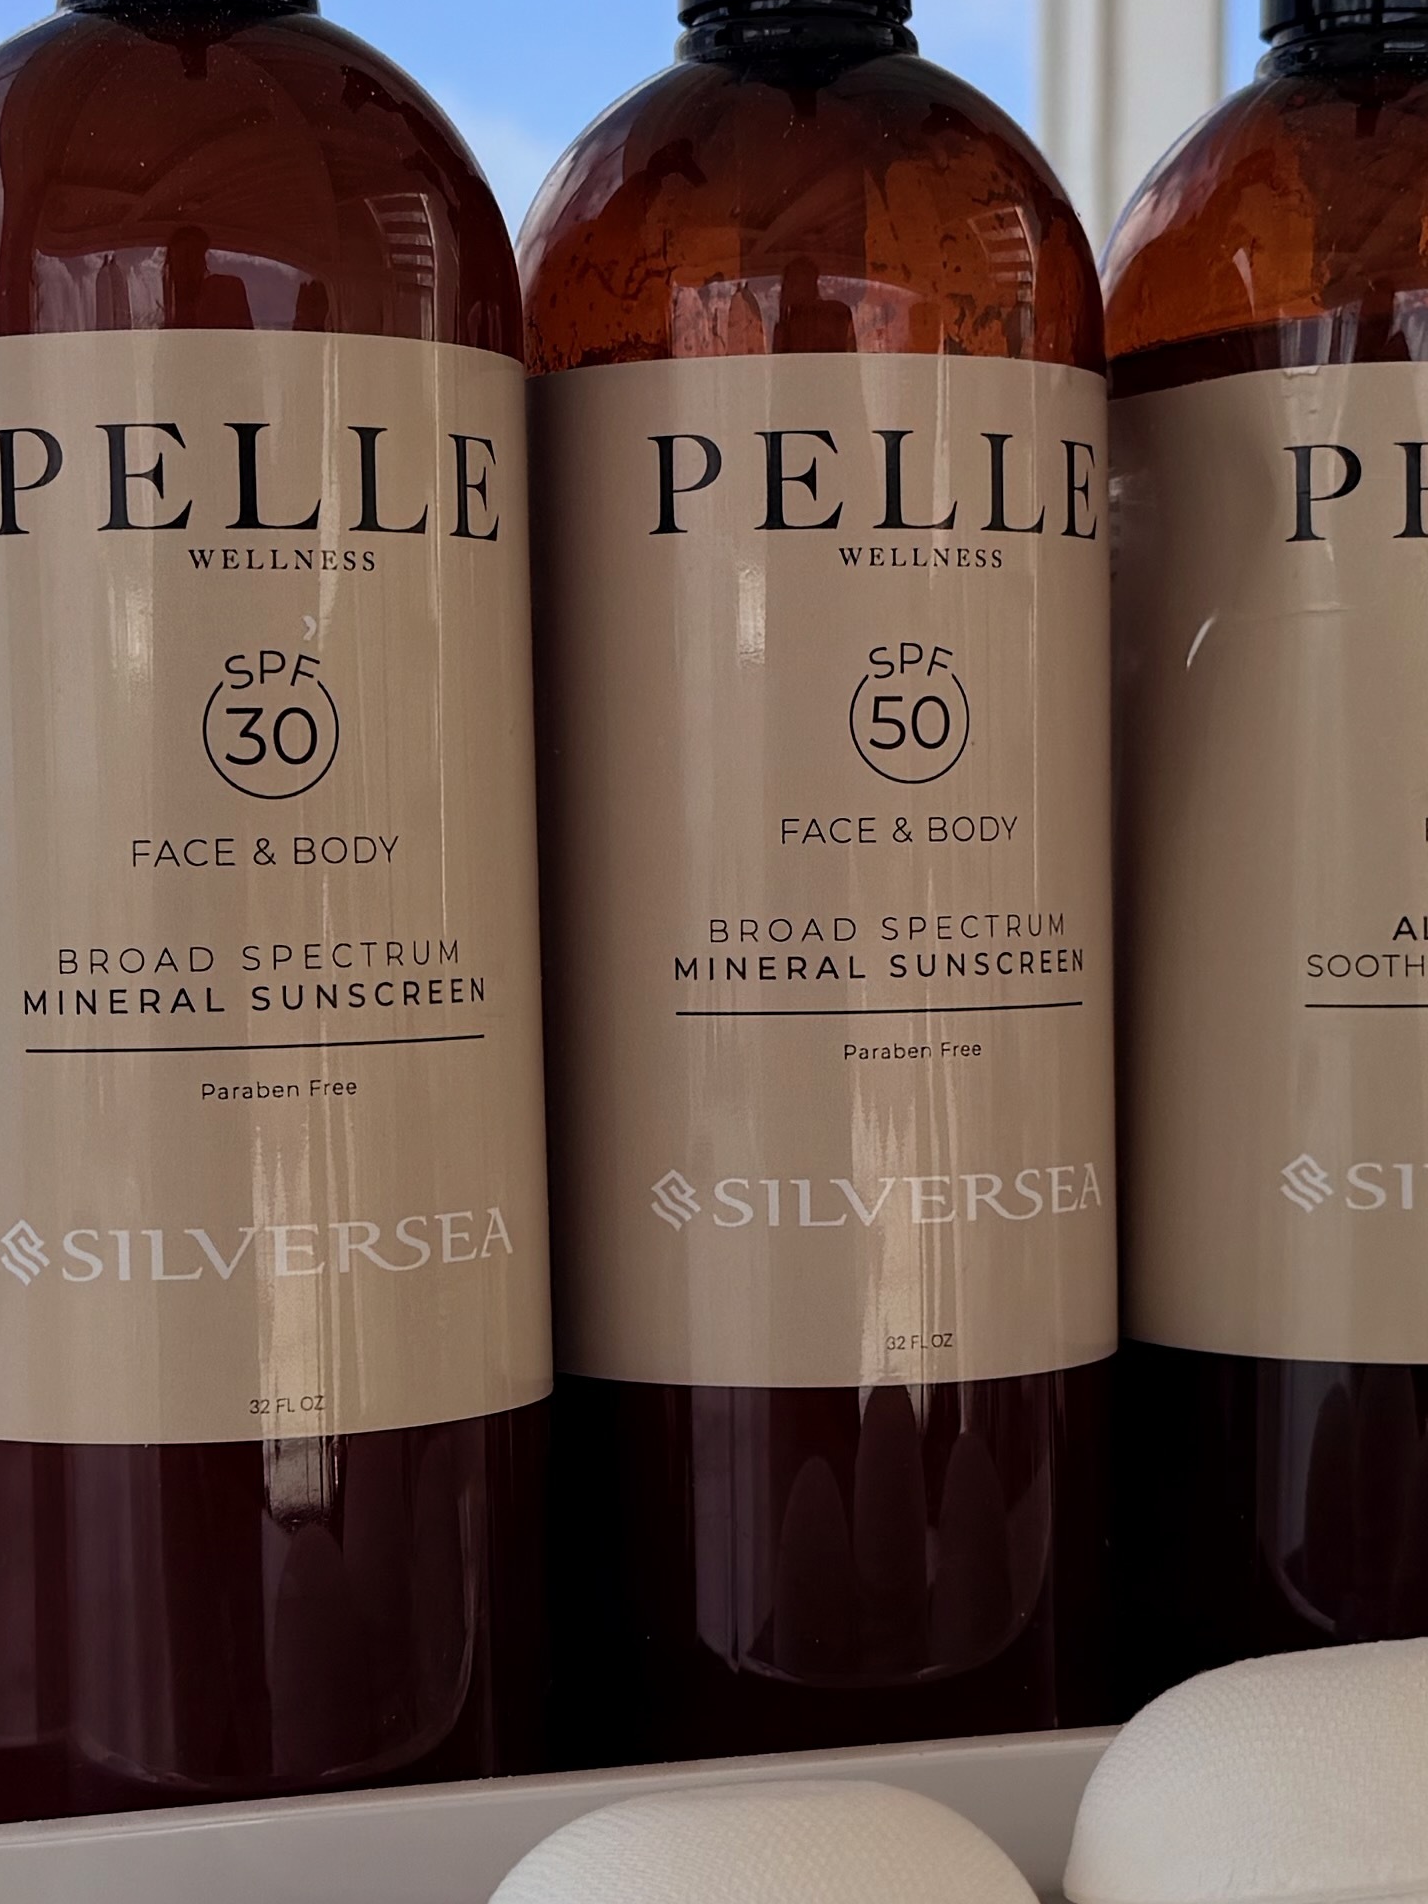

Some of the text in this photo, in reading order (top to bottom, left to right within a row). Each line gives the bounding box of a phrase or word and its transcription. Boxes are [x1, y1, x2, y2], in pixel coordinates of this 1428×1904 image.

[646, 429, 1097, 541] PELLE
[187, 548, 375, 572] WELLNESS
[838, 546, 1003, 569] WELLNESS
[224, 649, 321, 690] SPF
[868, 641, 954, 680] SPF
[224, 706, 318, 766] 30
[868, 695, 951, 751] 50
[781, 815, 1018, 845] FACE & BODY
[132, 835, 400, 868] FACE & BODY
[709, 912, 1064, 944] BROAD SPECTRUM
[58, 939, 459, 976] BROAD SPECTRUM
[674, 948, 1083, 982] MINERAL SUNSCREEN
[23, 976, 485, 1016] MINERAL SUNSCREEN
[843, 1041, 982, 1061] Paraben Free
[201, 1079, 358, 1101] Paraben Free
[713, 1162, 1101, 1229] SILVERSEA
[61, 1206, 513, 1282] SILVERSEA
[886, 1333, 953, 1350] 32 FL OZ
[250, 1395, 325, 1414] 32 FL OZ
